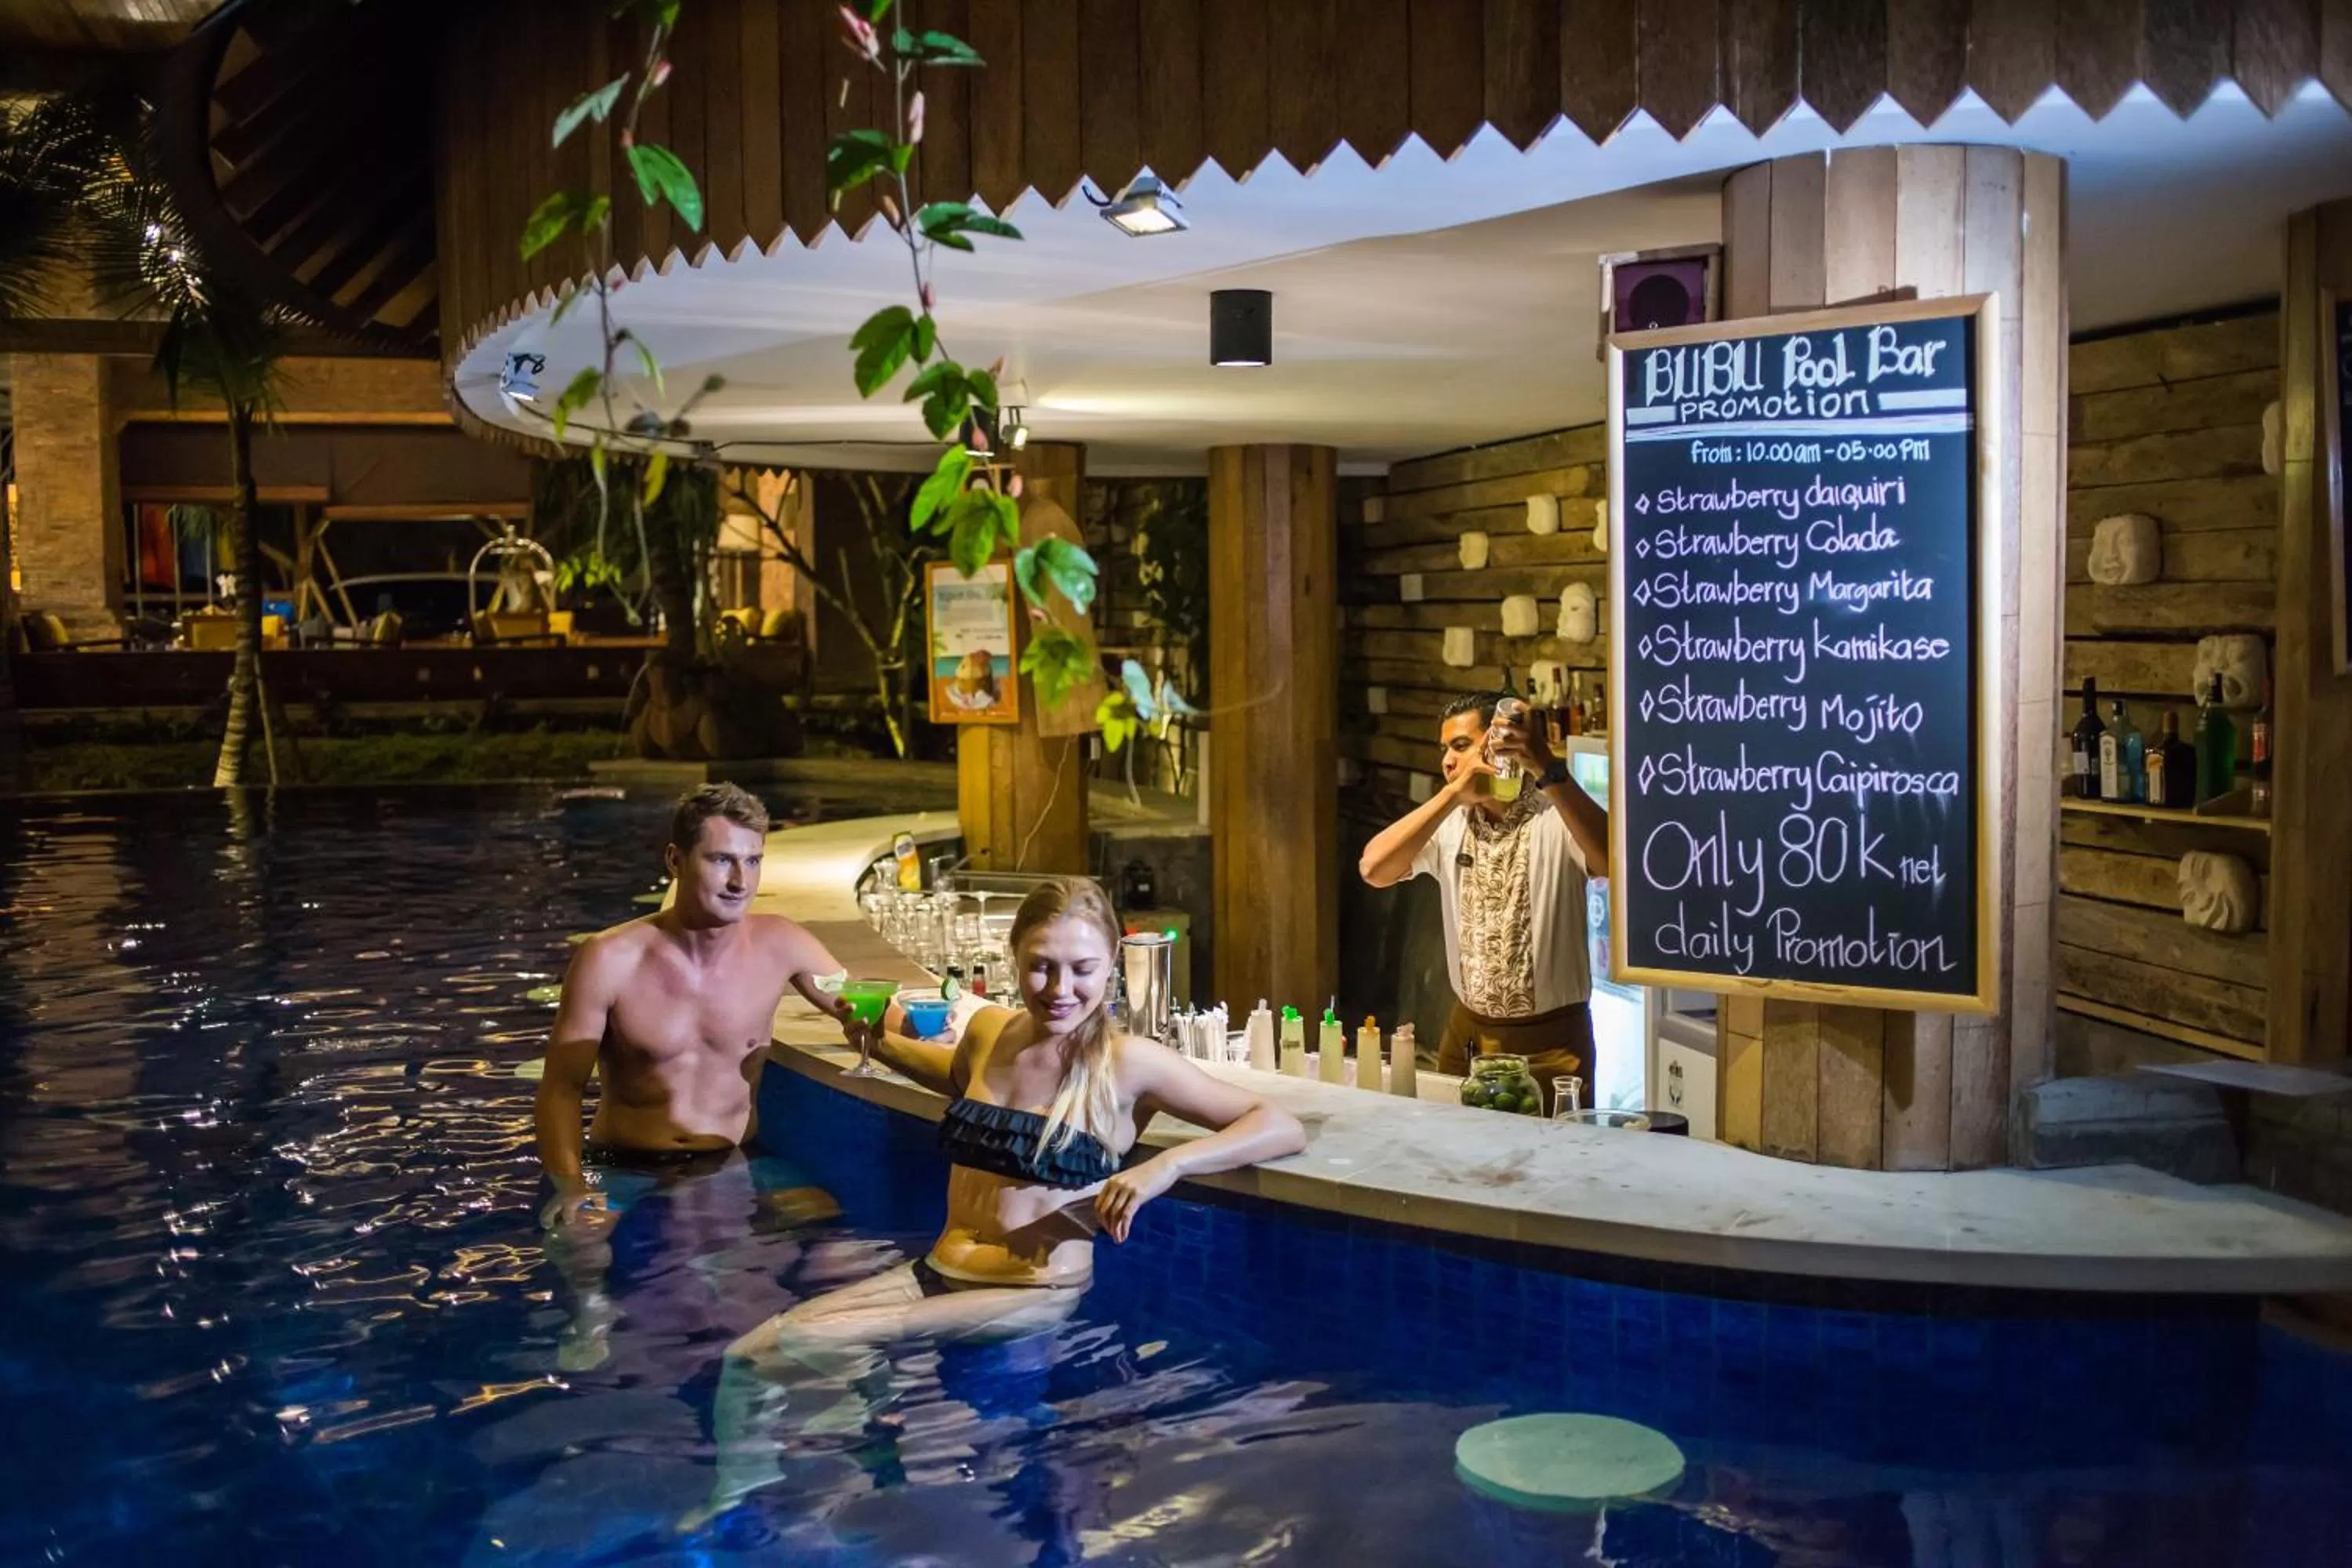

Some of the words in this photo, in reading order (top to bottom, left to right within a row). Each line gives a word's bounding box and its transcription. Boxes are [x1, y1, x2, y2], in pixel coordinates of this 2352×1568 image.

[1646, 340, 1764, 406] BUBU
[1782, 331, 1856, 391] Pool
[1867, 325, 1947, 383] Bar
[1656, 477, 1800, 521] Strawberry
[1654, 518, 1800, 569] Strawberry
[1806, 512, 1902, 555] Colada
[1652, 568, 1800, 615] Strawberry
[1808, 569, 1935, 613] Margarita
[1652, 616, 1806, 684] Strawberry
[1657, 673, 1807, 731] Strawberry
[1821, 693, 1924, 744] Mojito
[1657, 742, 1813, 811] Strawberry
[1816, 750, 1960, 808] Caipirosca
[1642, 810, 1765, 917] Only
[1655, 899, 1755, 975] daily
[1766, 905, 1958, 972] Promotion
